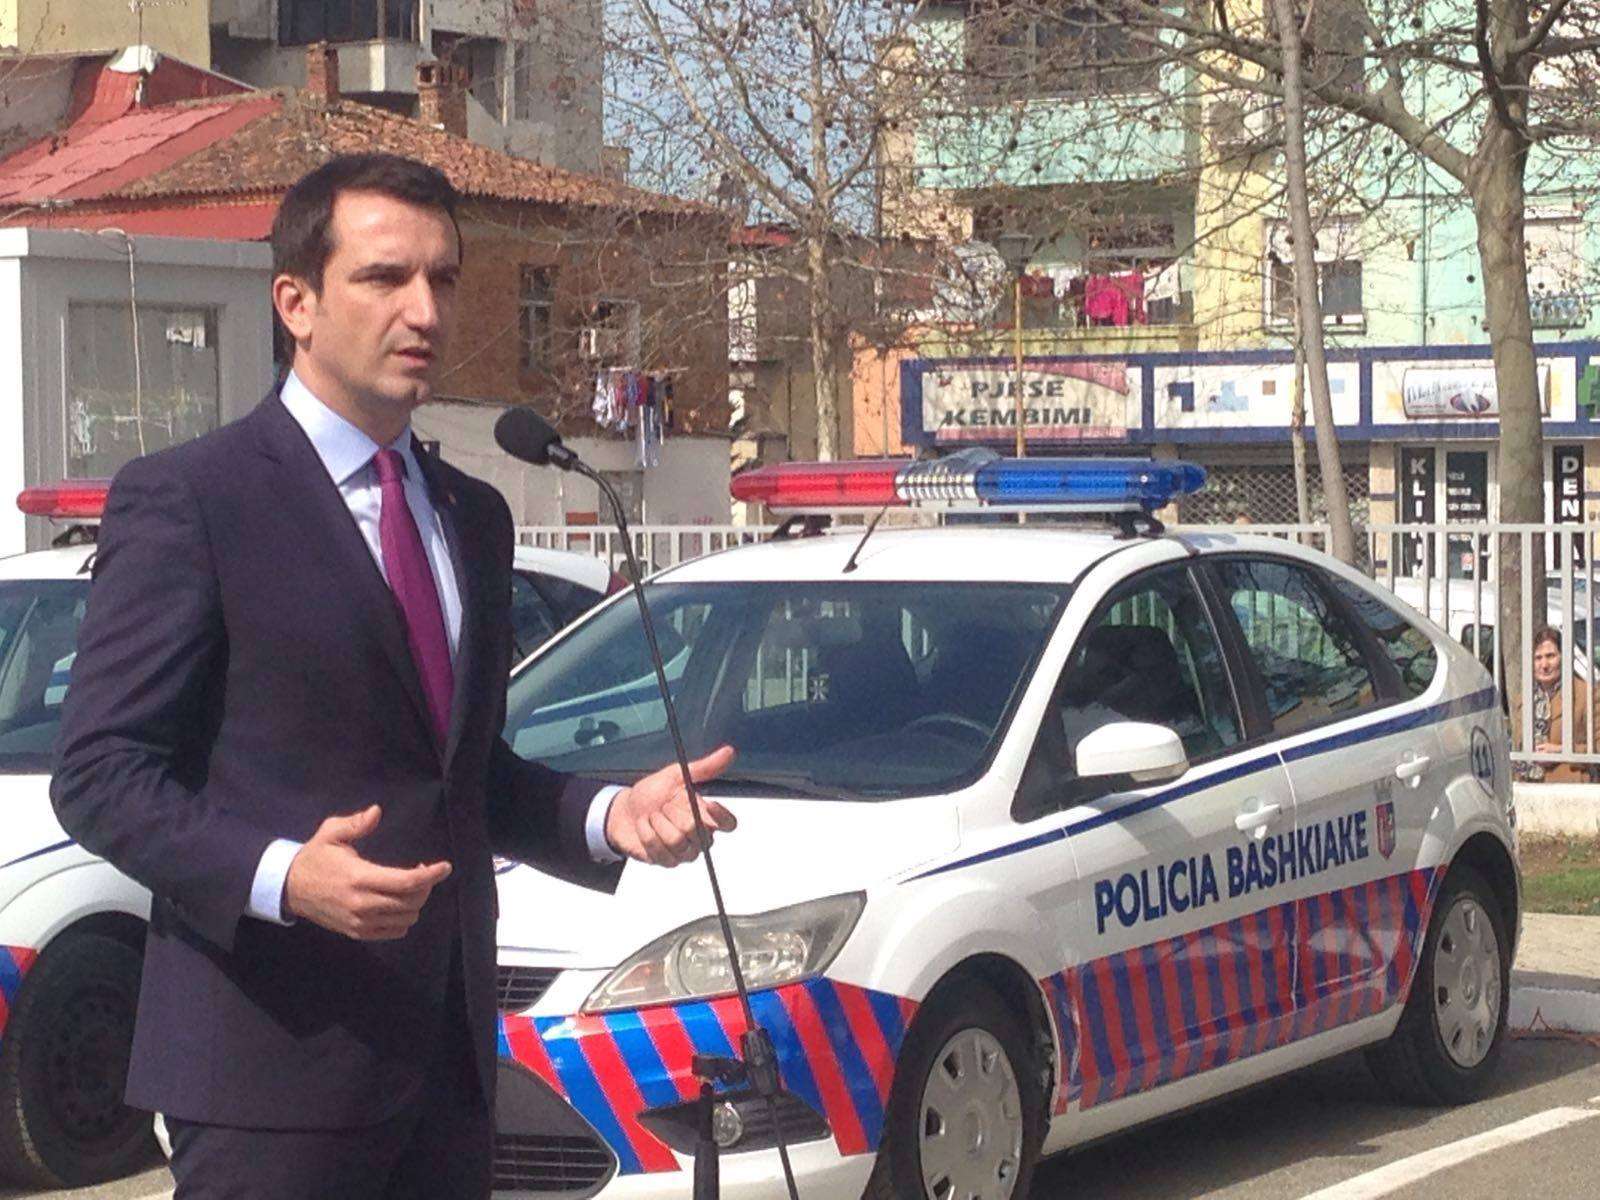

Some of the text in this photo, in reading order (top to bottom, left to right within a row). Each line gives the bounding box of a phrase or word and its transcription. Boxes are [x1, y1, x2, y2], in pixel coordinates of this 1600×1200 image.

[945, 408, 1091, 425] KEMBIMI
[1094, 811, 1369, 934] POLICIA BASHKIAKE
